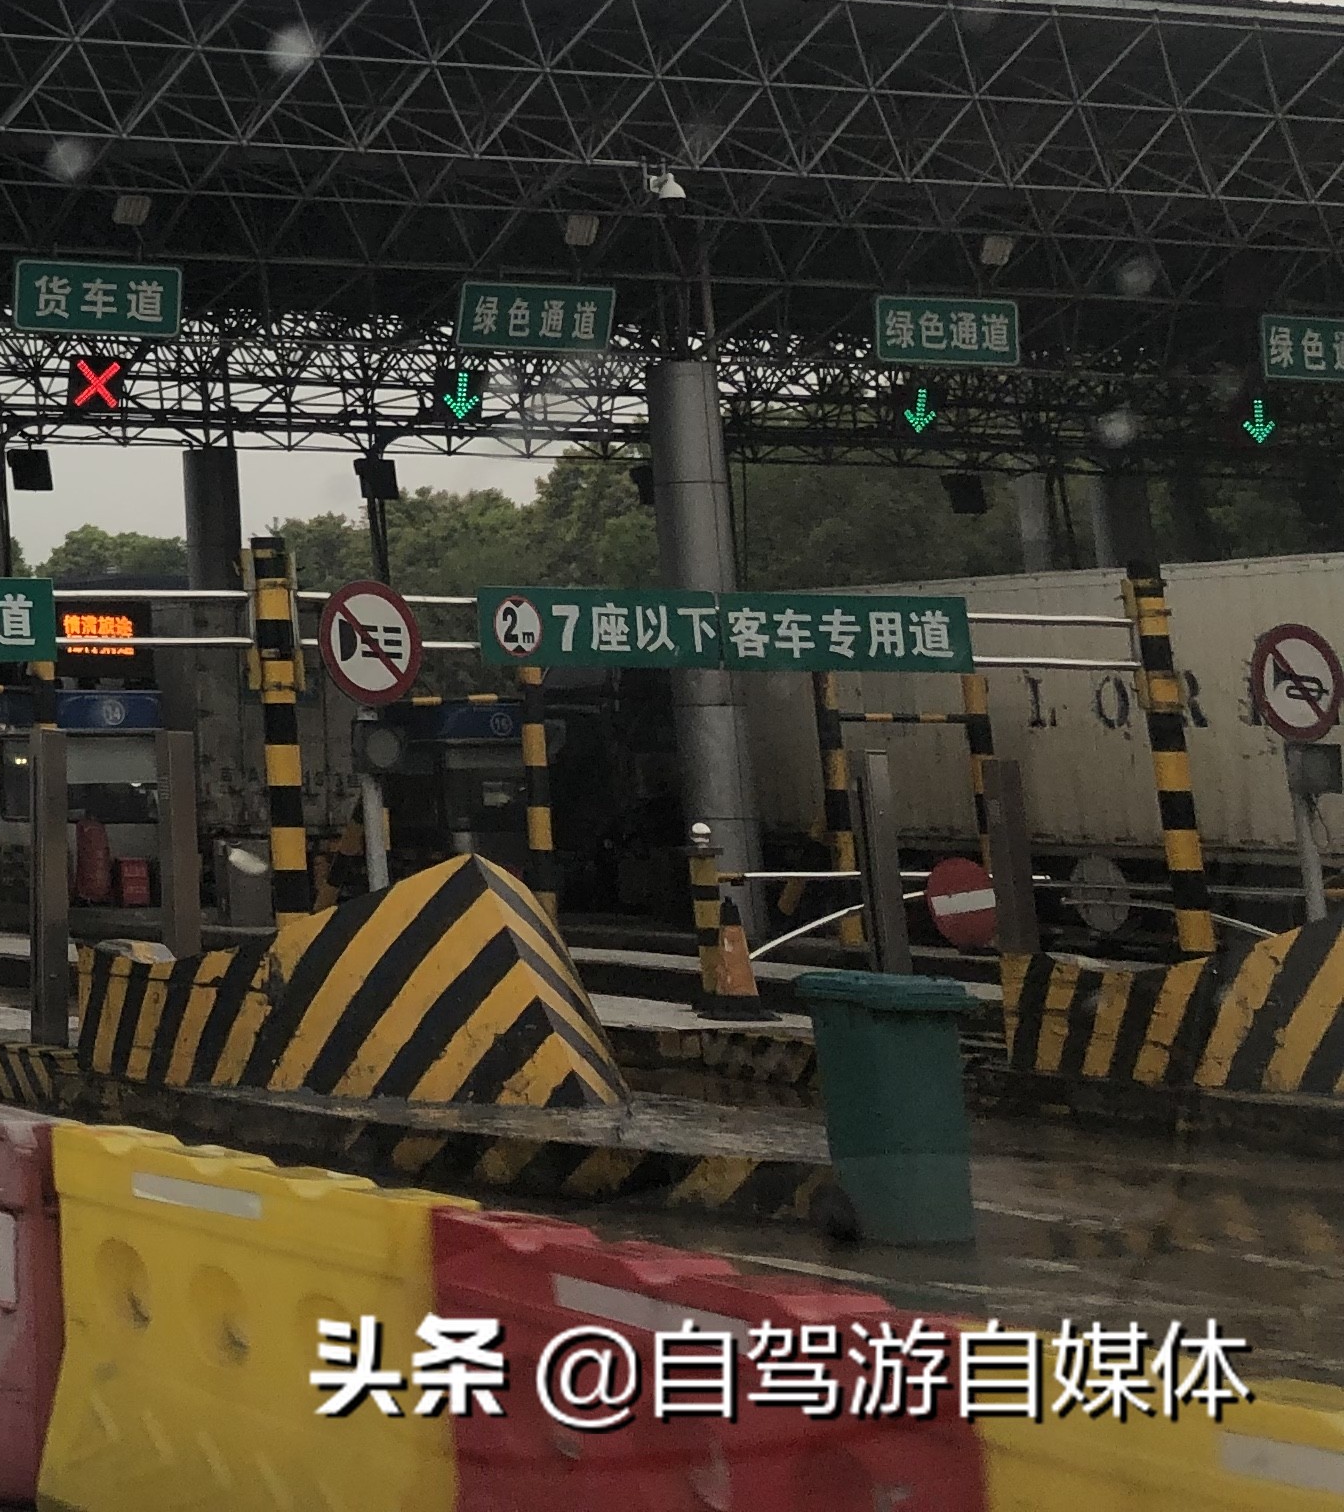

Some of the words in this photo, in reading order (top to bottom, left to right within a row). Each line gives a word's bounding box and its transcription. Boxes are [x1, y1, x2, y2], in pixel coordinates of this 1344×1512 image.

[34, 275, 164, 322] 货车道
[472, 295, 598, 340] 绿色通道
[885, 309, 1010, 352] 绿色通道
[551, 603, 955, 659] 7座以下客车专用道
